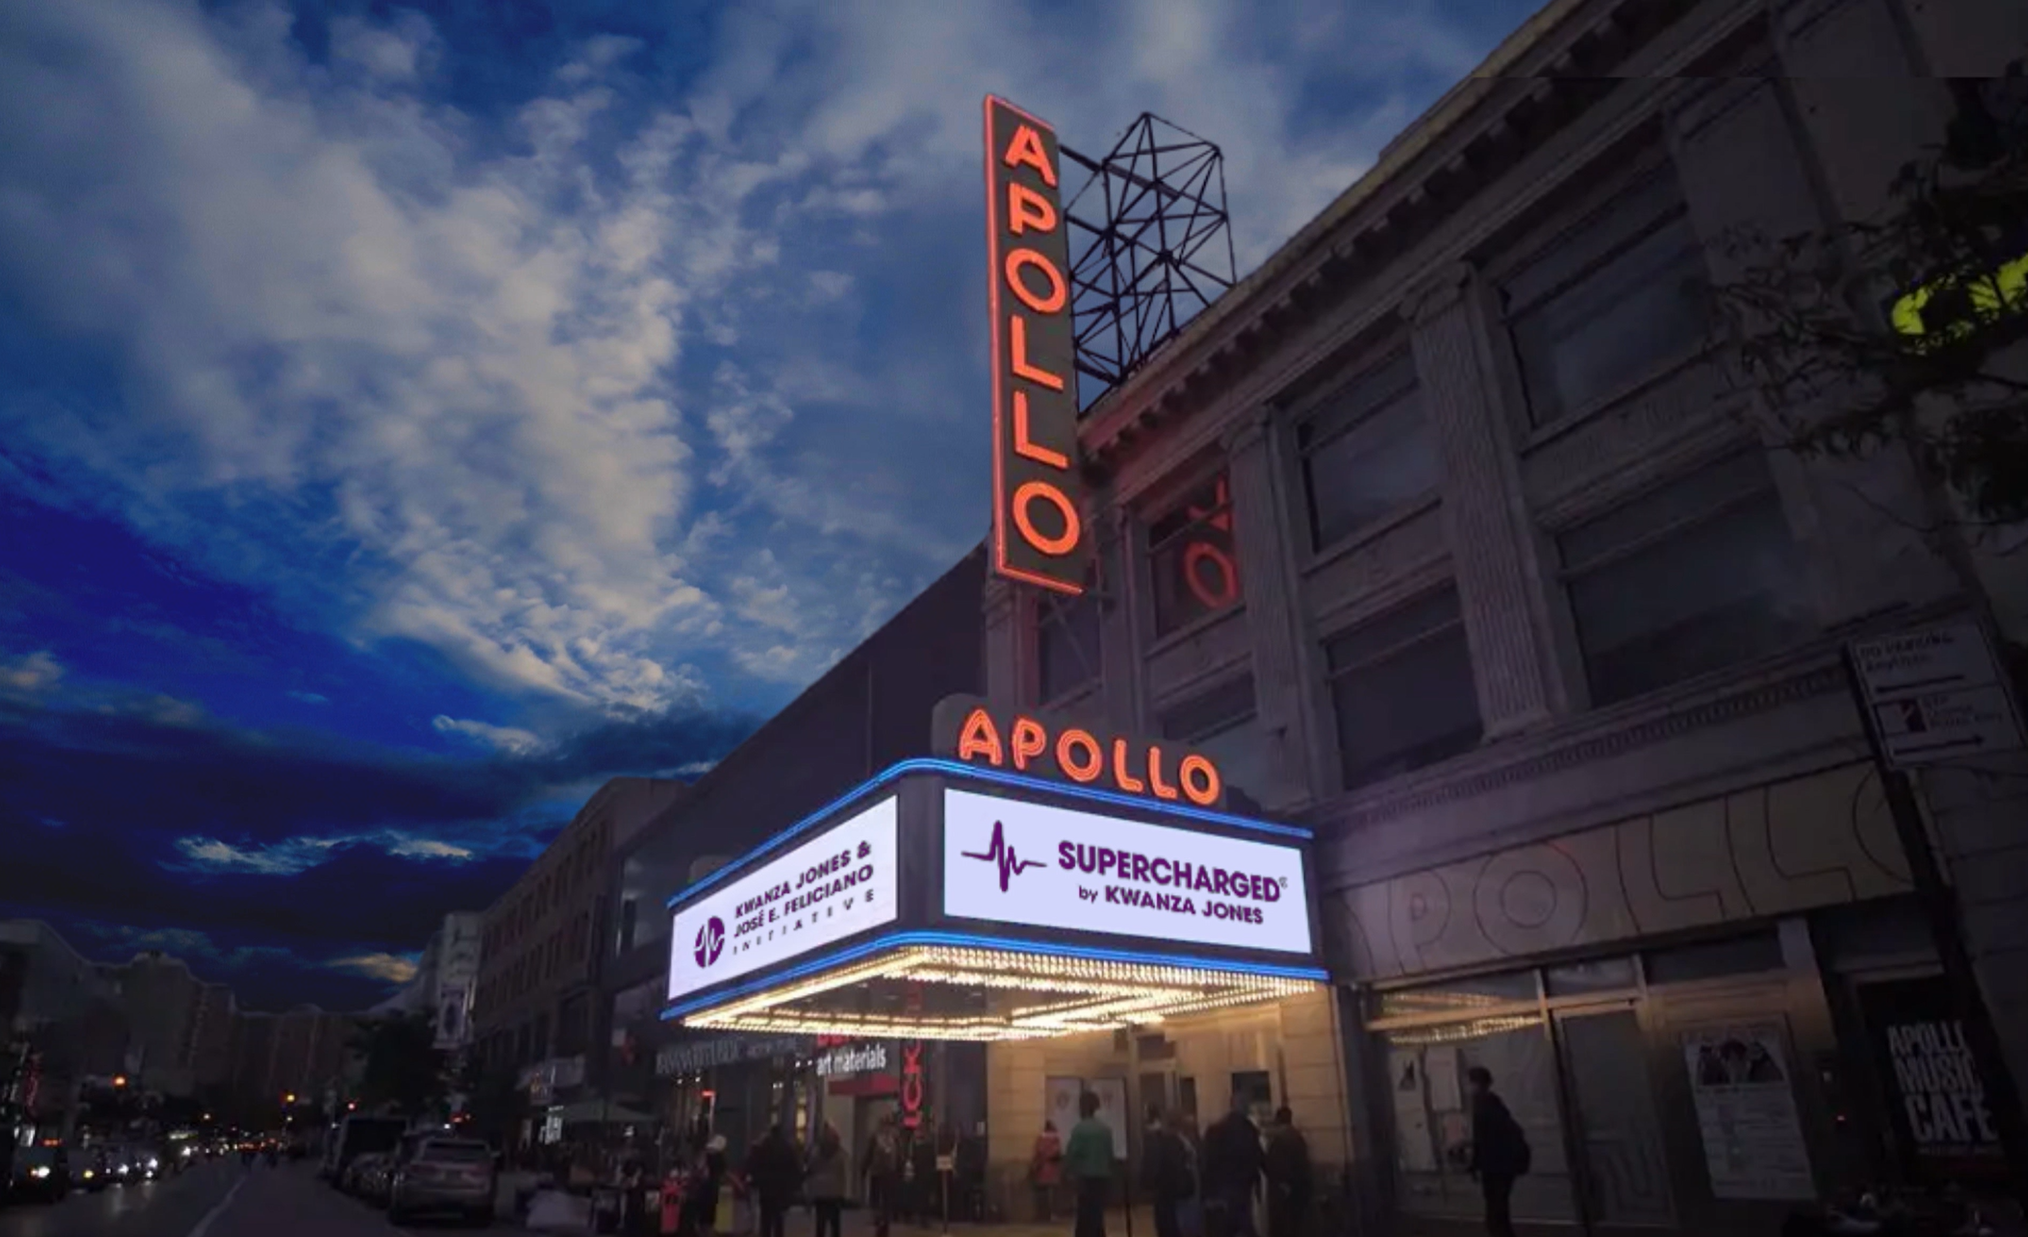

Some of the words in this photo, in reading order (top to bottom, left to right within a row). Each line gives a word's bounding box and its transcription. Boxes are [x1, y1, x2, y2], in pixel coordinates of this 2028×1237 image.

[1004, 123, 1081, 557] APOLLO
[958, 707, 1221, 806] APOLLO
[734, 881, 791, 919] KWANZA
[796, 849, 851, 889] JONES
[857, 840, 872, 859] &
[734, 910, 764, 938] JOSÉ
[769, 910, 780, 923] E.
[784, 864, 874, 916] FELICIANO
[1078, 885, 1098, 904] by
[1104, 885, 1196, 915] KWANZA
[1202, 900, 1264, 925] JONES
[815, 1052, 832, 1077] art
[834, 1042, 887, 1073] materials
